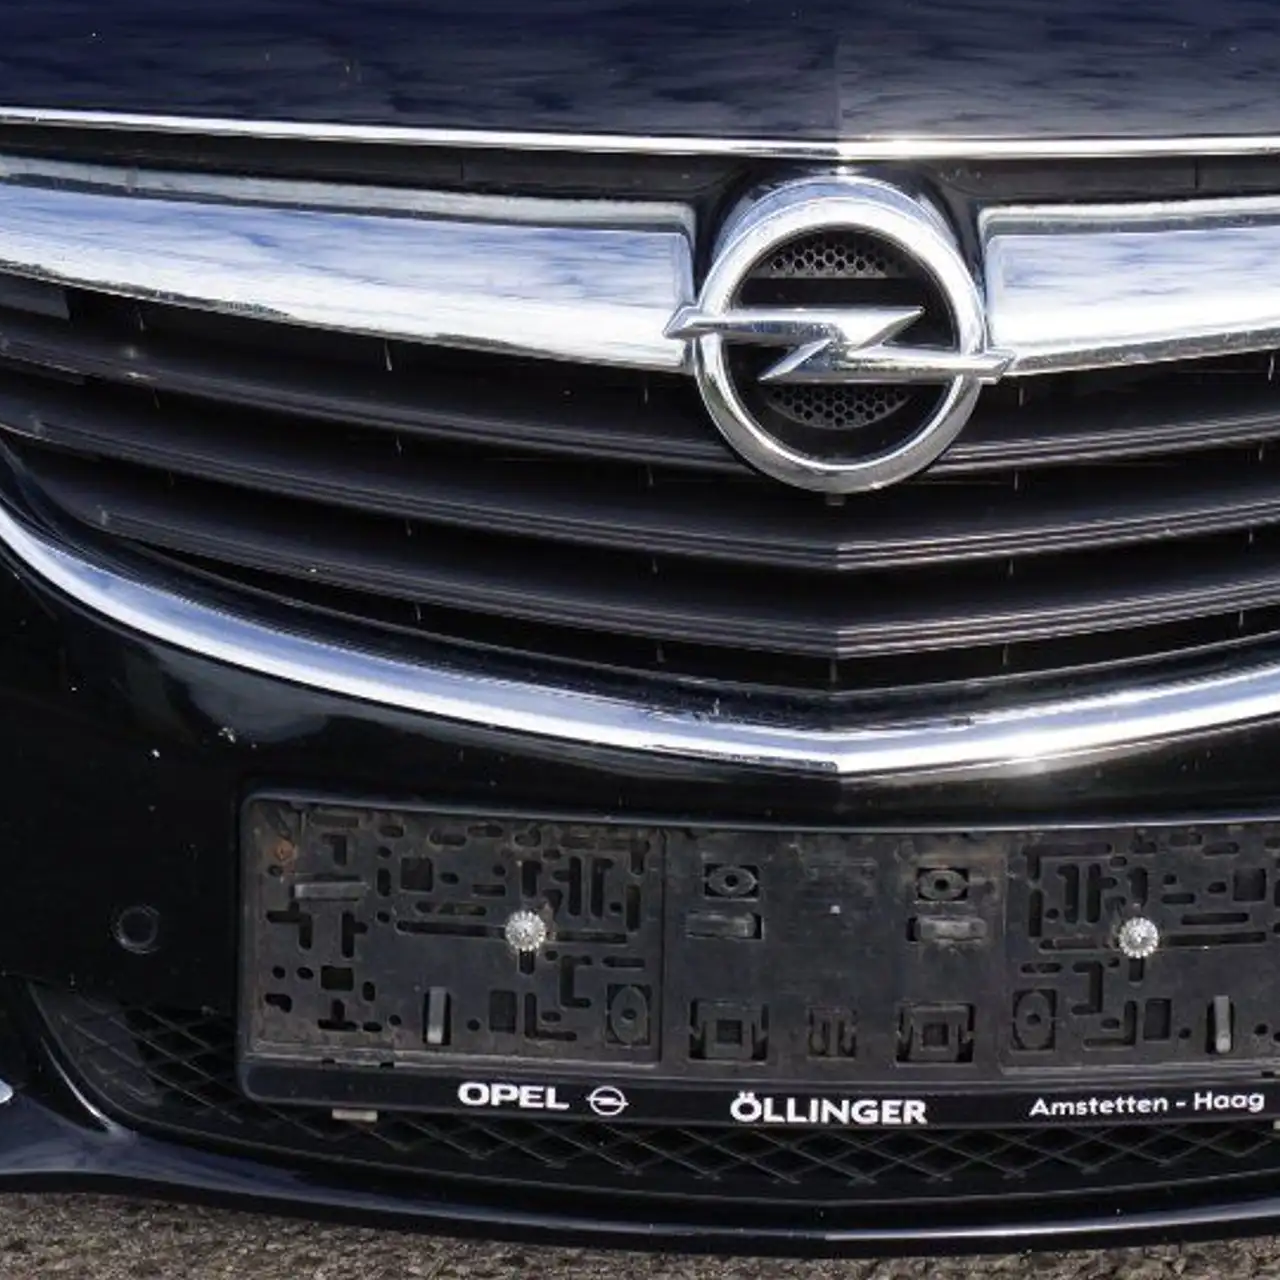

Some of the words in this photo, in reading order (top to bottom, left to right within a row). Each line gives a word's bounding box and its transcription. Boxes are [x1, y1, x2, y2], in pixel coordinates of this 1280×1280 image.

[457, 1080, 570, 1110] OPEL
[729, 1090, 928, 1125] ÖLLINGER
[1028, 1094, 1169, 1117] Amstetten
[1193, 1091, 1266, 1113] Haag
